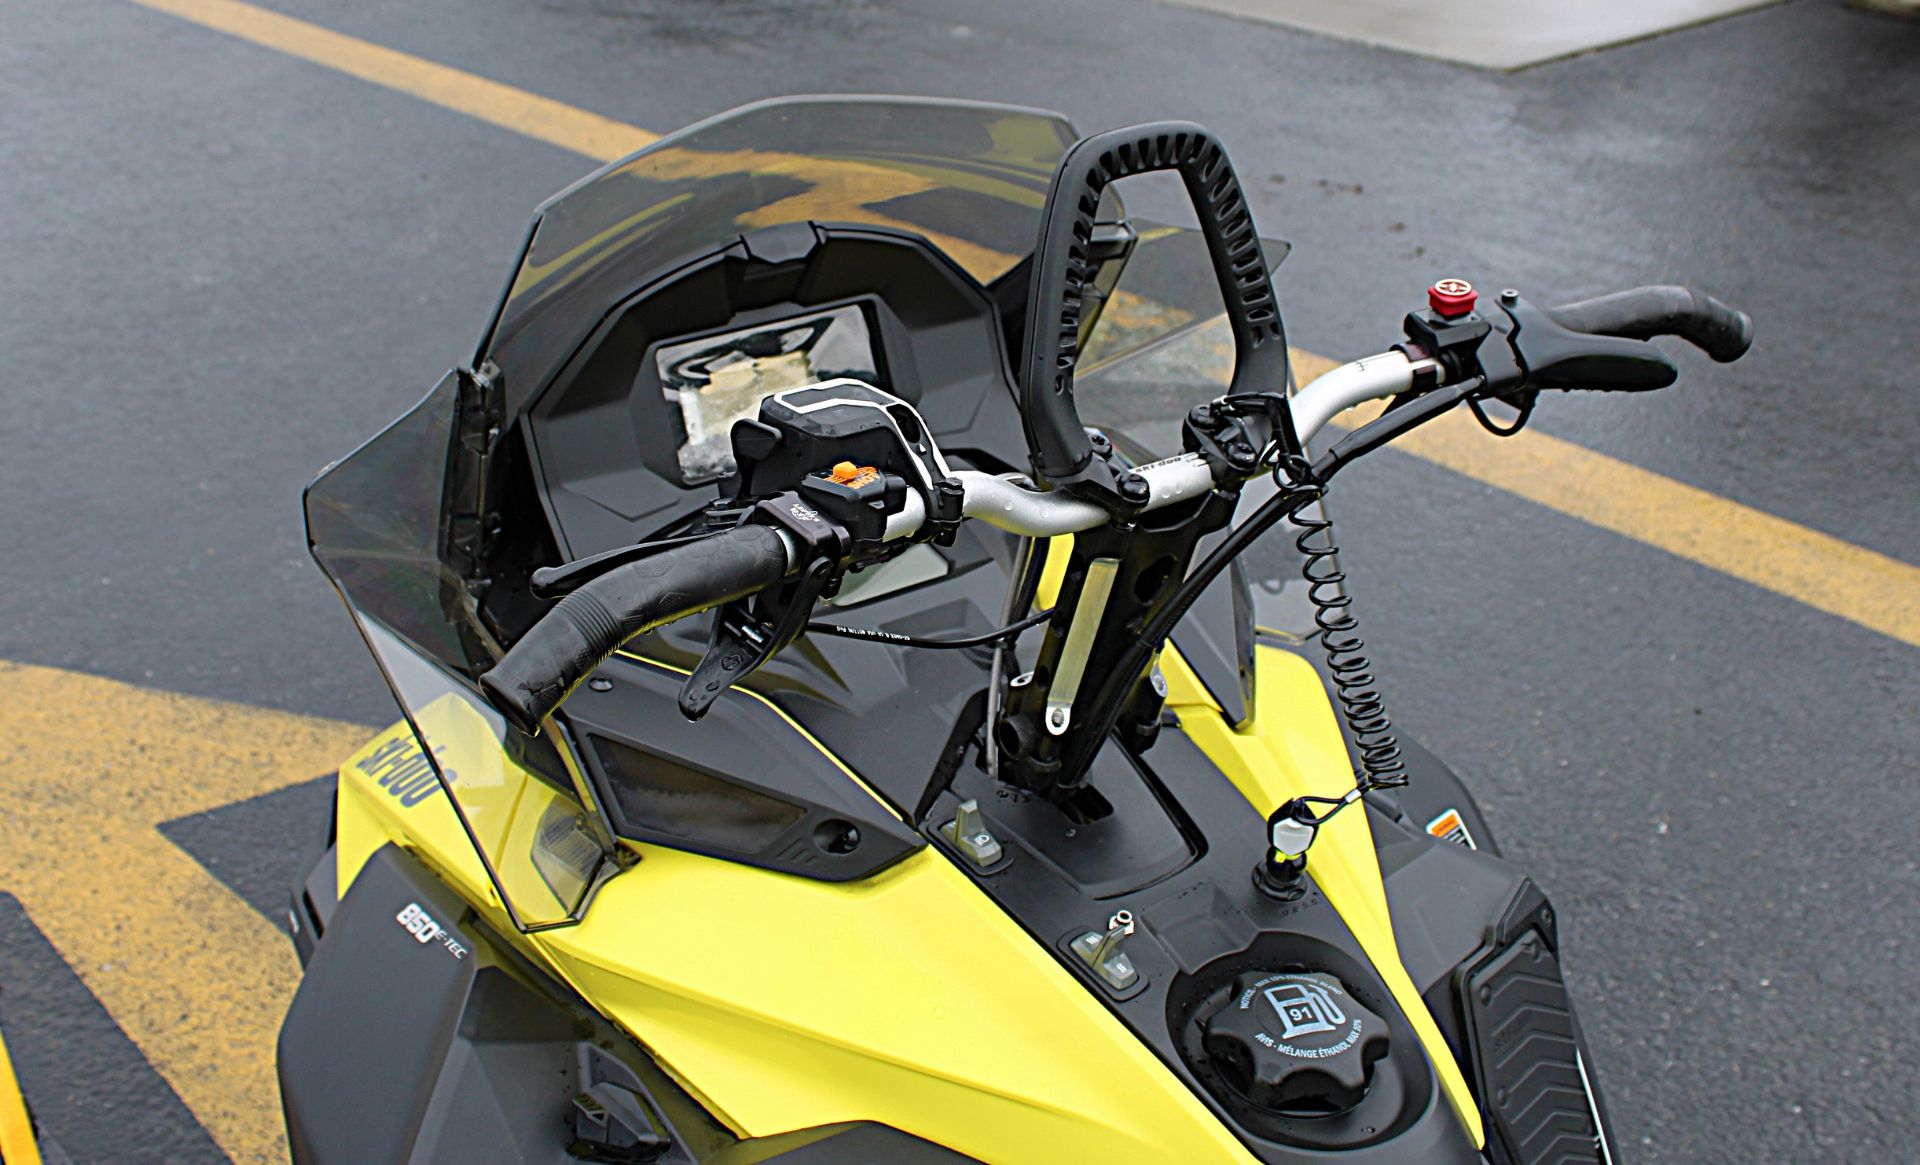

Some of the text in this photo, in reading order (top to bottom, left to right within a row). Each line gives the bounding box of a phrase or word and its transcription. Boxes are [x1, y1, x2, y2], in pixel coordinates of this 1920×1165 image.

[396, 903, 468, 960] 850 E-TEC
[1289, 1006, 1313, 1021] 91
[1255, 1032, 1274, 1048] AVIS
[1277, 1043, 1318, 1059] MÉLANGE
[1319, 1040, 1351, 1058] ÉTHANOL
